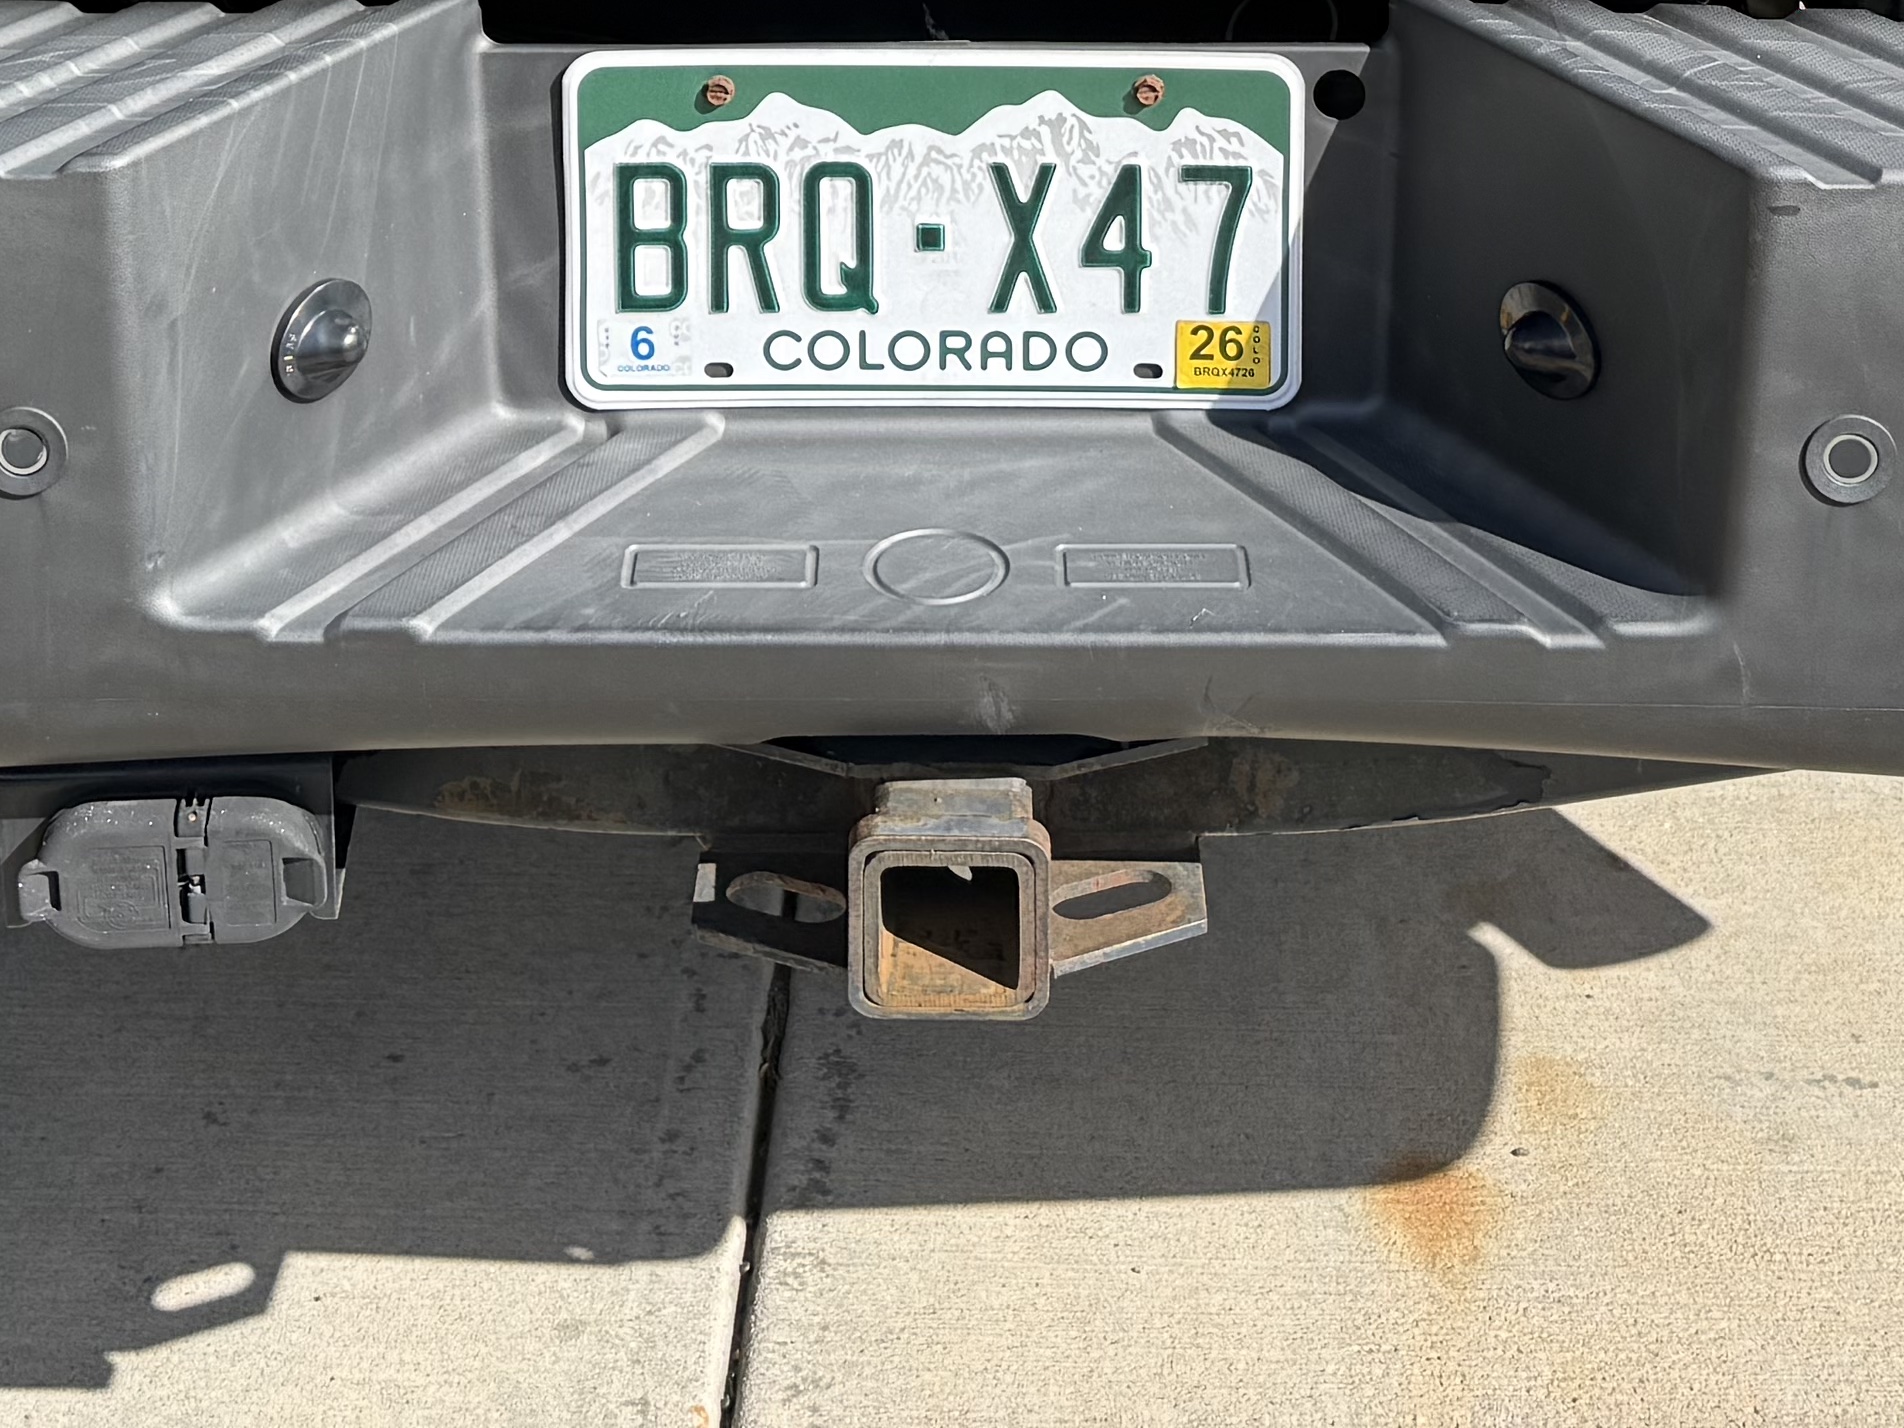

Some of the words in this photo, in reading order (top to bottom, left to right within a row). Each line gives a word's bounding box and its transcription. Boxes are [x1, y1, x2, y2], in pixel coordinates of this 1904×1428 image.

[630, 325, 655, 360] 6
[763, 329, 1109, 372] COLORADO
[1189, 324, 1244, 361] 26
[617, 364, 671, 373] COLORADO
